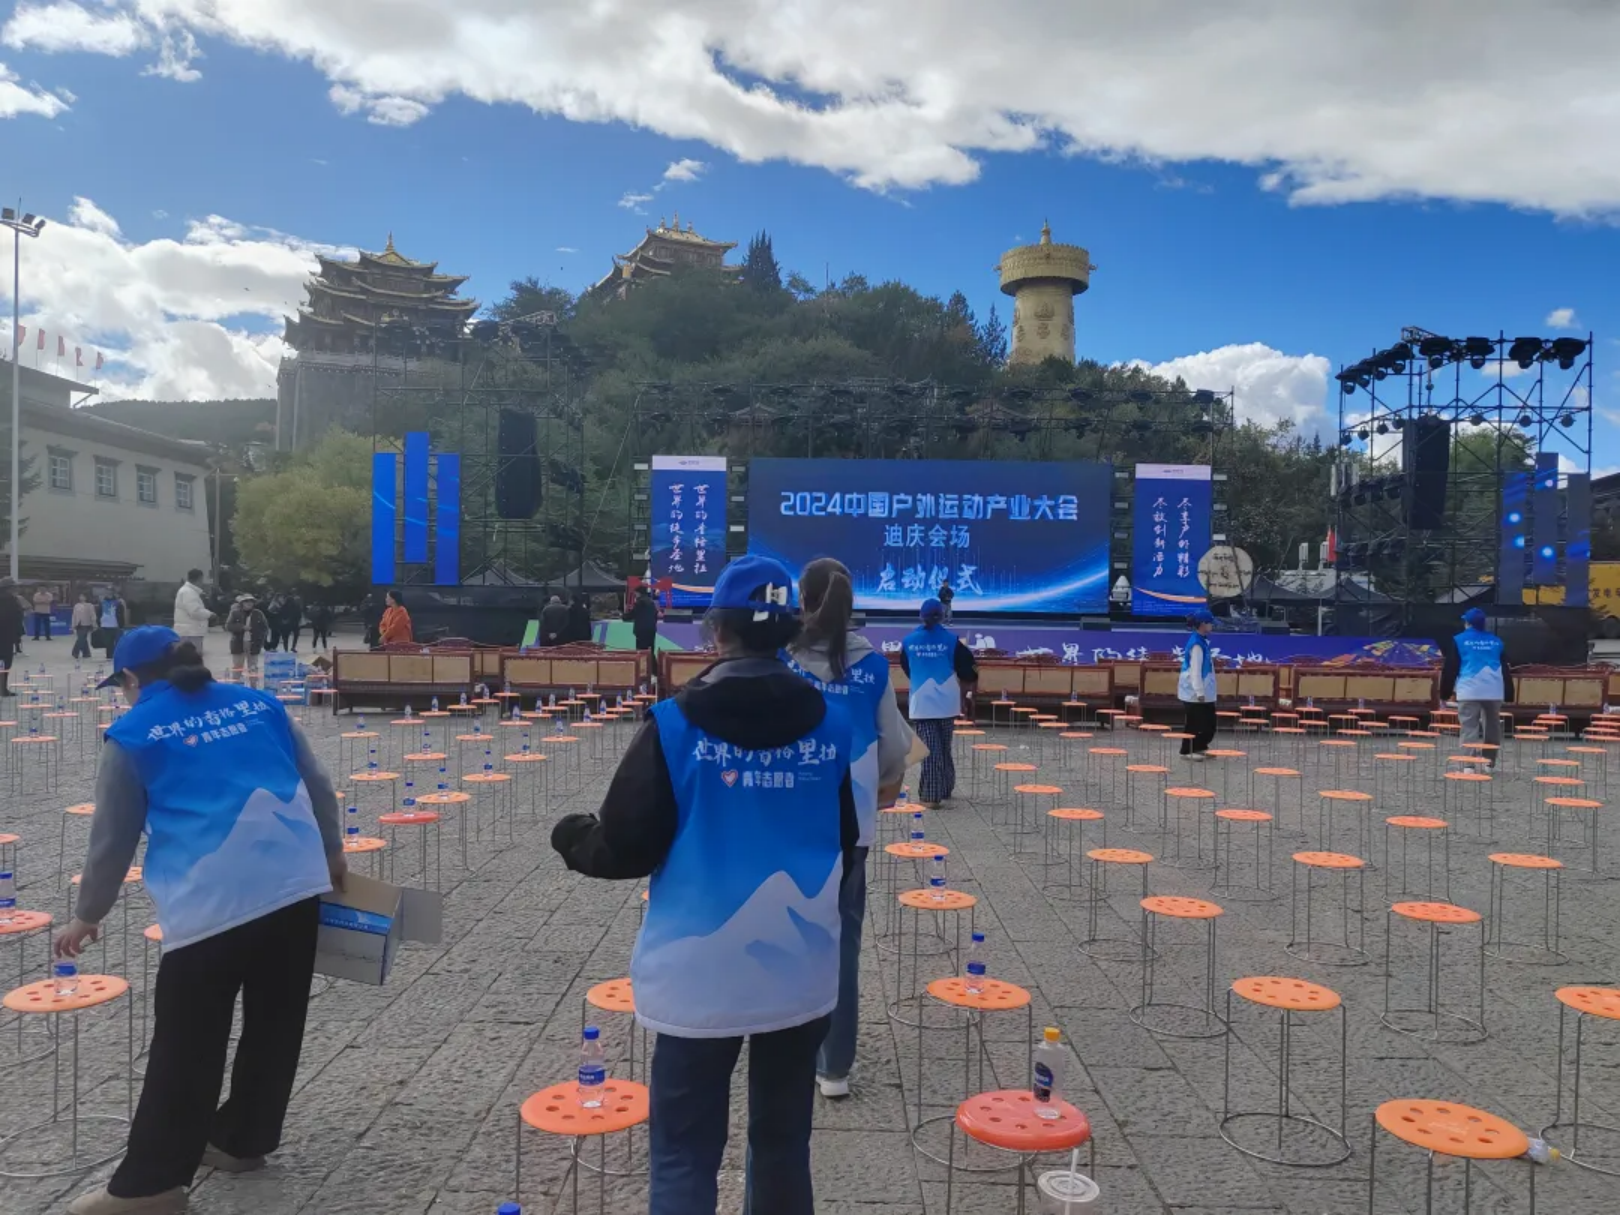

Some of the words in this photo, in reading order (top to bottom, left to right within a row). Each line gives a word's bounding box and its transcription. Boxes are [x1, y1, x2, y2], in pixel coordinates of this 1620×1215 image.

[780, 491, 1079, 521] 2024中国户外运动产业大会
[883, 523, 971, 549] 迪庆会场
[876, 563, 983, 595] 启动仪式
[147, 699, 272, 741] 世界的香格里拉
[742, 770, 795, 789] 青年志愿者
